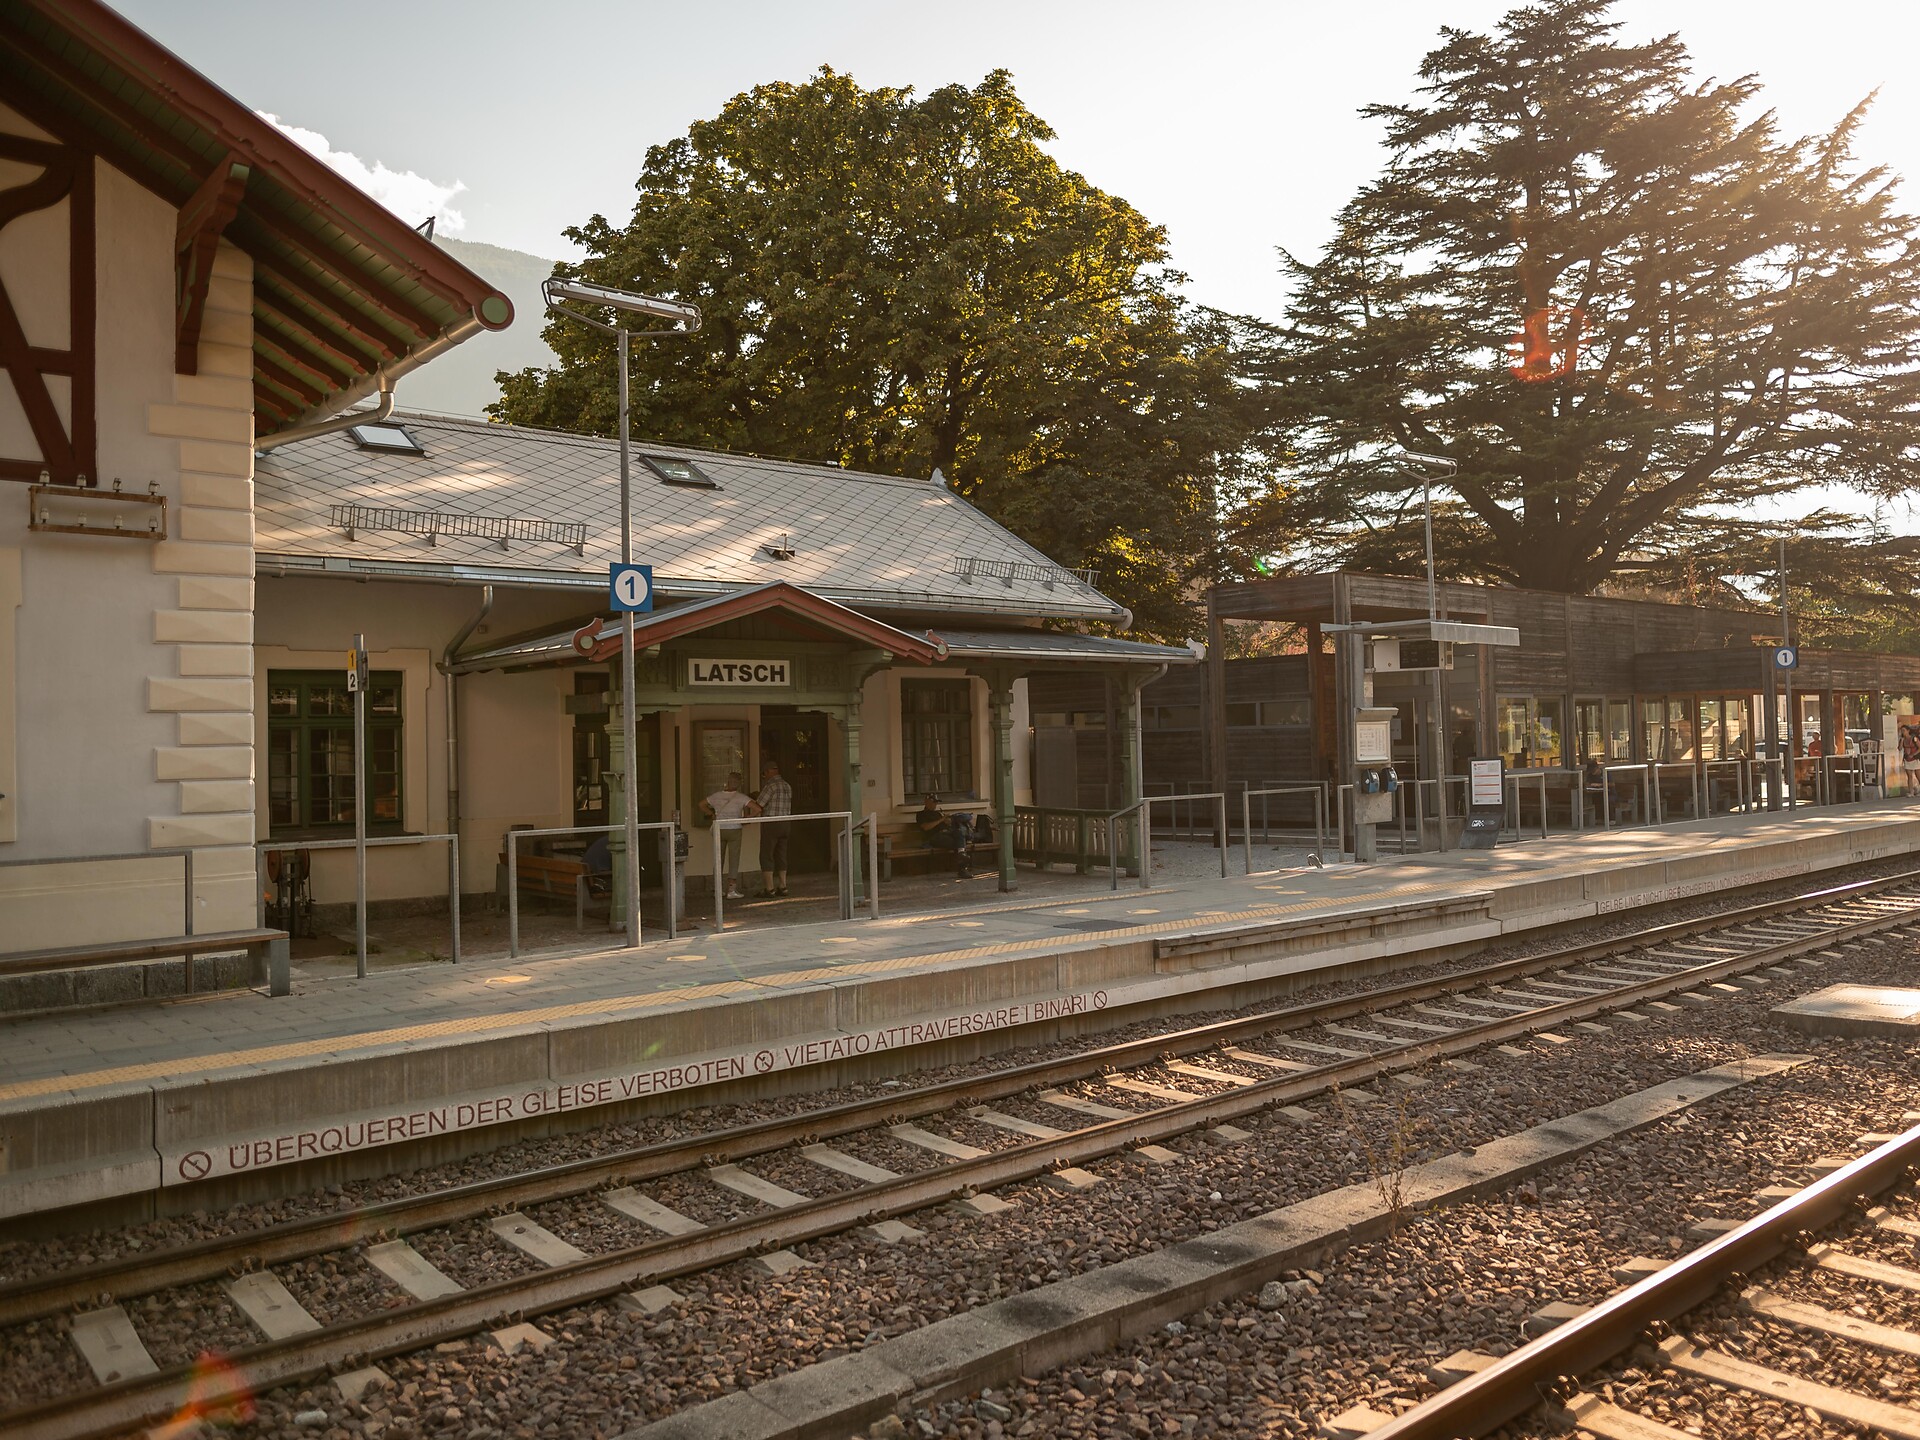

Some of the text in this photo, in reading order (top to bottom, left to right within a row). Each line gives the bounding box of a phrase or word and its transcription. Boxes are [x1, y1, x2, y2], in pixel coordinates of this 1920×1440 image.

[624, 575, 635, 600] 1
[1782, 652, 1788, 663] 1
[350, 673, 356, 687] 2
[694, 663, 785, 682] LATSCH
[1600, 898, 1623, 913] GELBE
[1624, 894, 1642, 909] LINIE
[1643, 890, 1662, 905] NICHT
[229, 1108, 446, 1169] ÜBERQUEREN
[457, 1098, 514, 1128] DER
[522, 1080, 612, 1114] GLEISE
[620, 1057, 745, 1097] VERBOTEN
[785, 1034, 870, 1066] VIETATO
[875, 1007, 1019, 1050] ATTRAVERSARE
[1034, 995, 1086, 1020] BINARI
